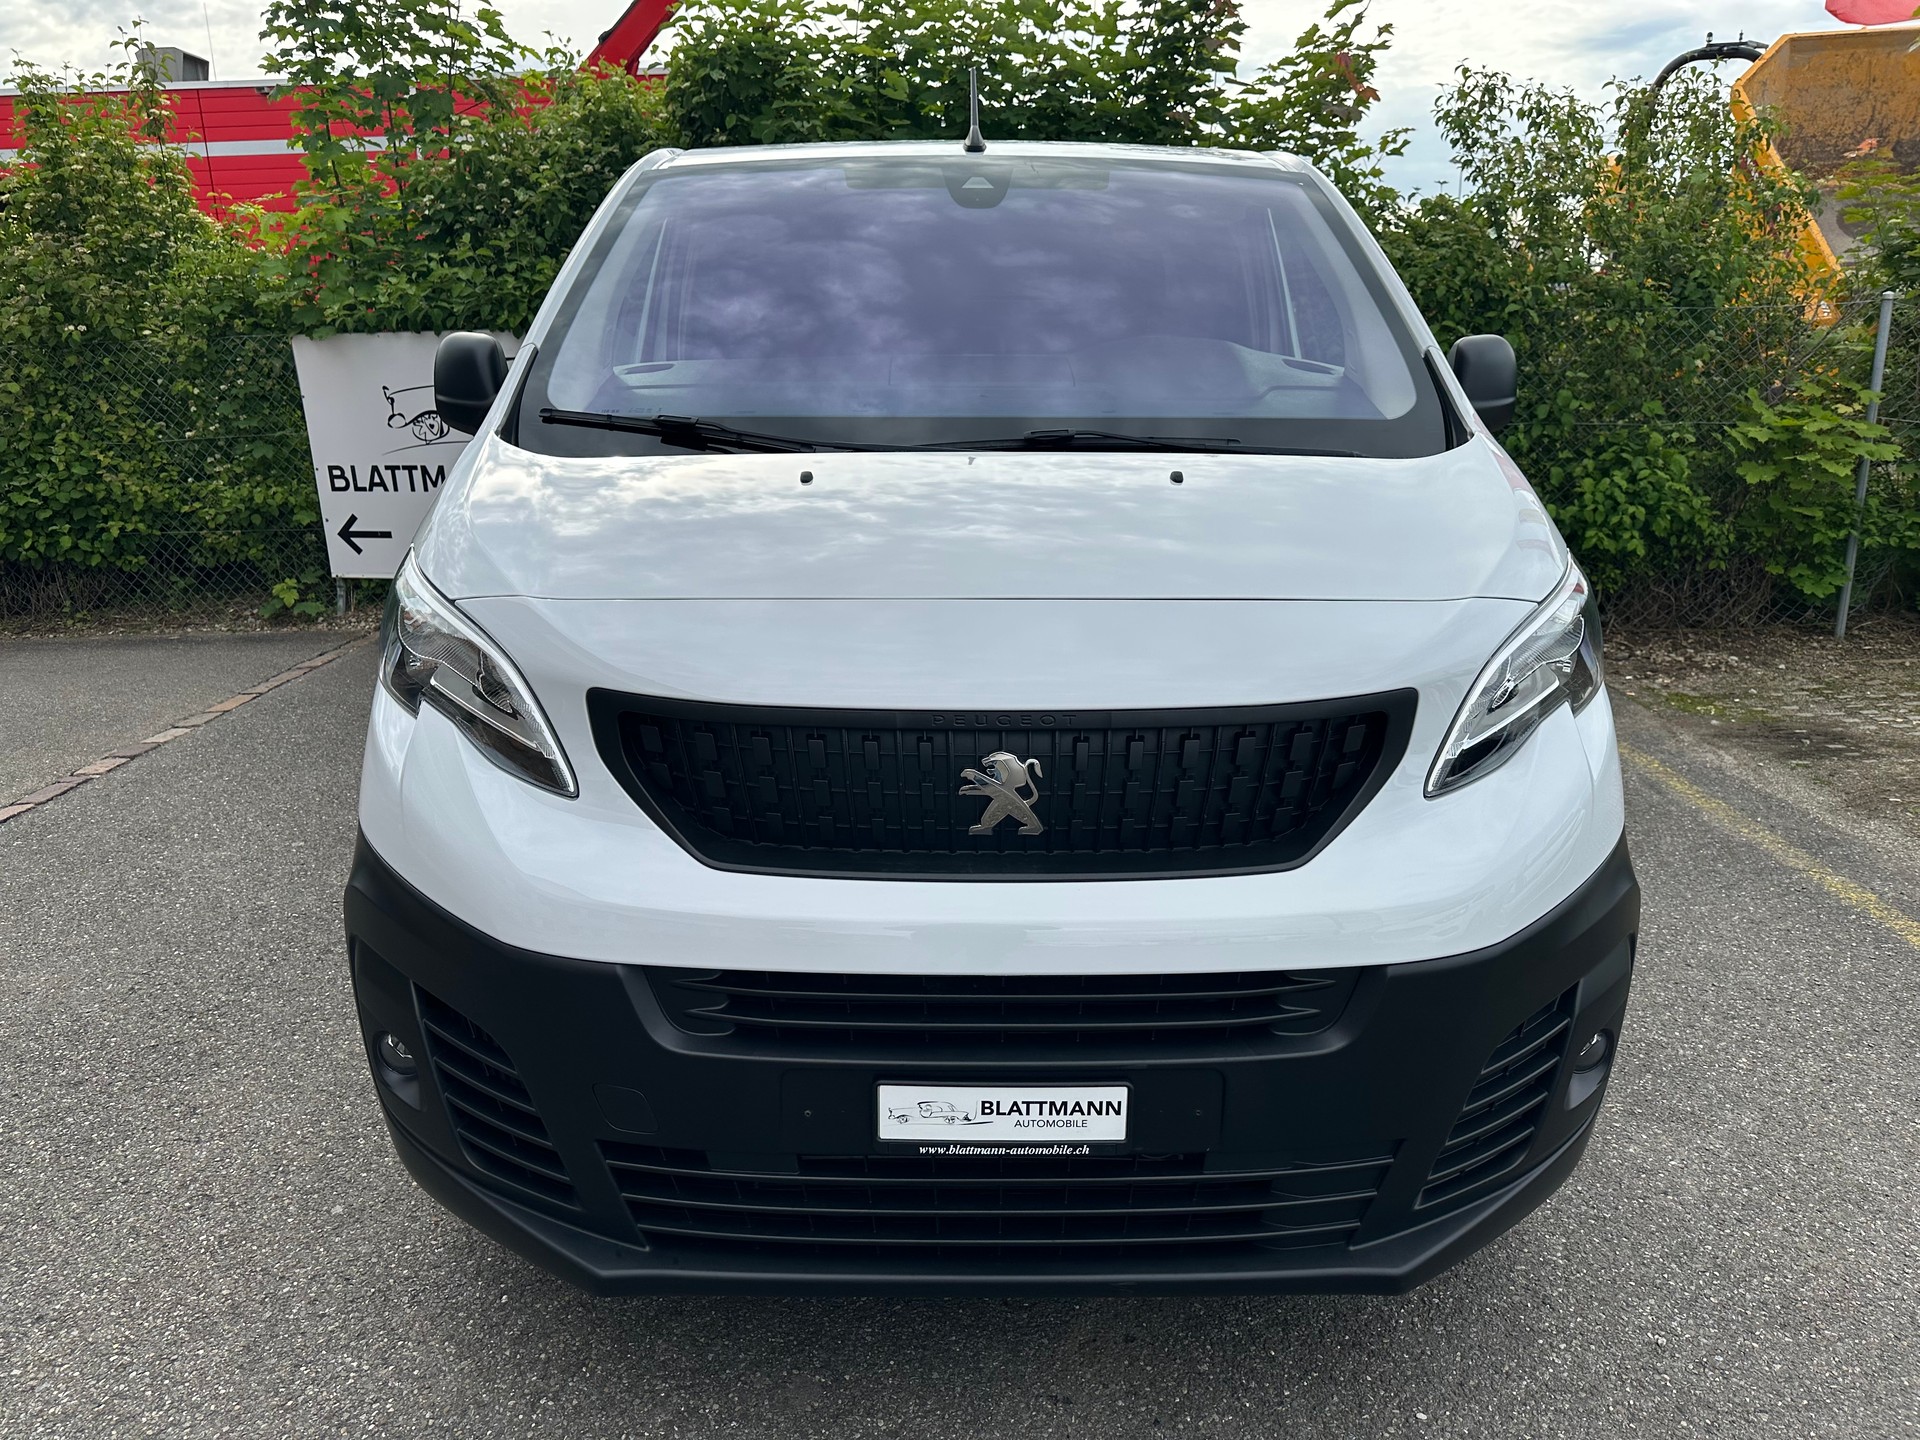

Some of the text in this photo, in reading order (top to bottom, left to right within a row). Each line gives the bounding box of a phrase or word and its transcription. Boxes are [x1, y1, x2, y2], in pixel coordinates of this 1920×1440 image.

[932, 714, 1076, 727] PEUGEOT
[980, 1100, 1122, 1116] BLATTMANN
[1014, 1119, 1088, 1128] AUTOMOBILE
[919, 1145, 1090, 1155] www.blattmann-automobile.ch
